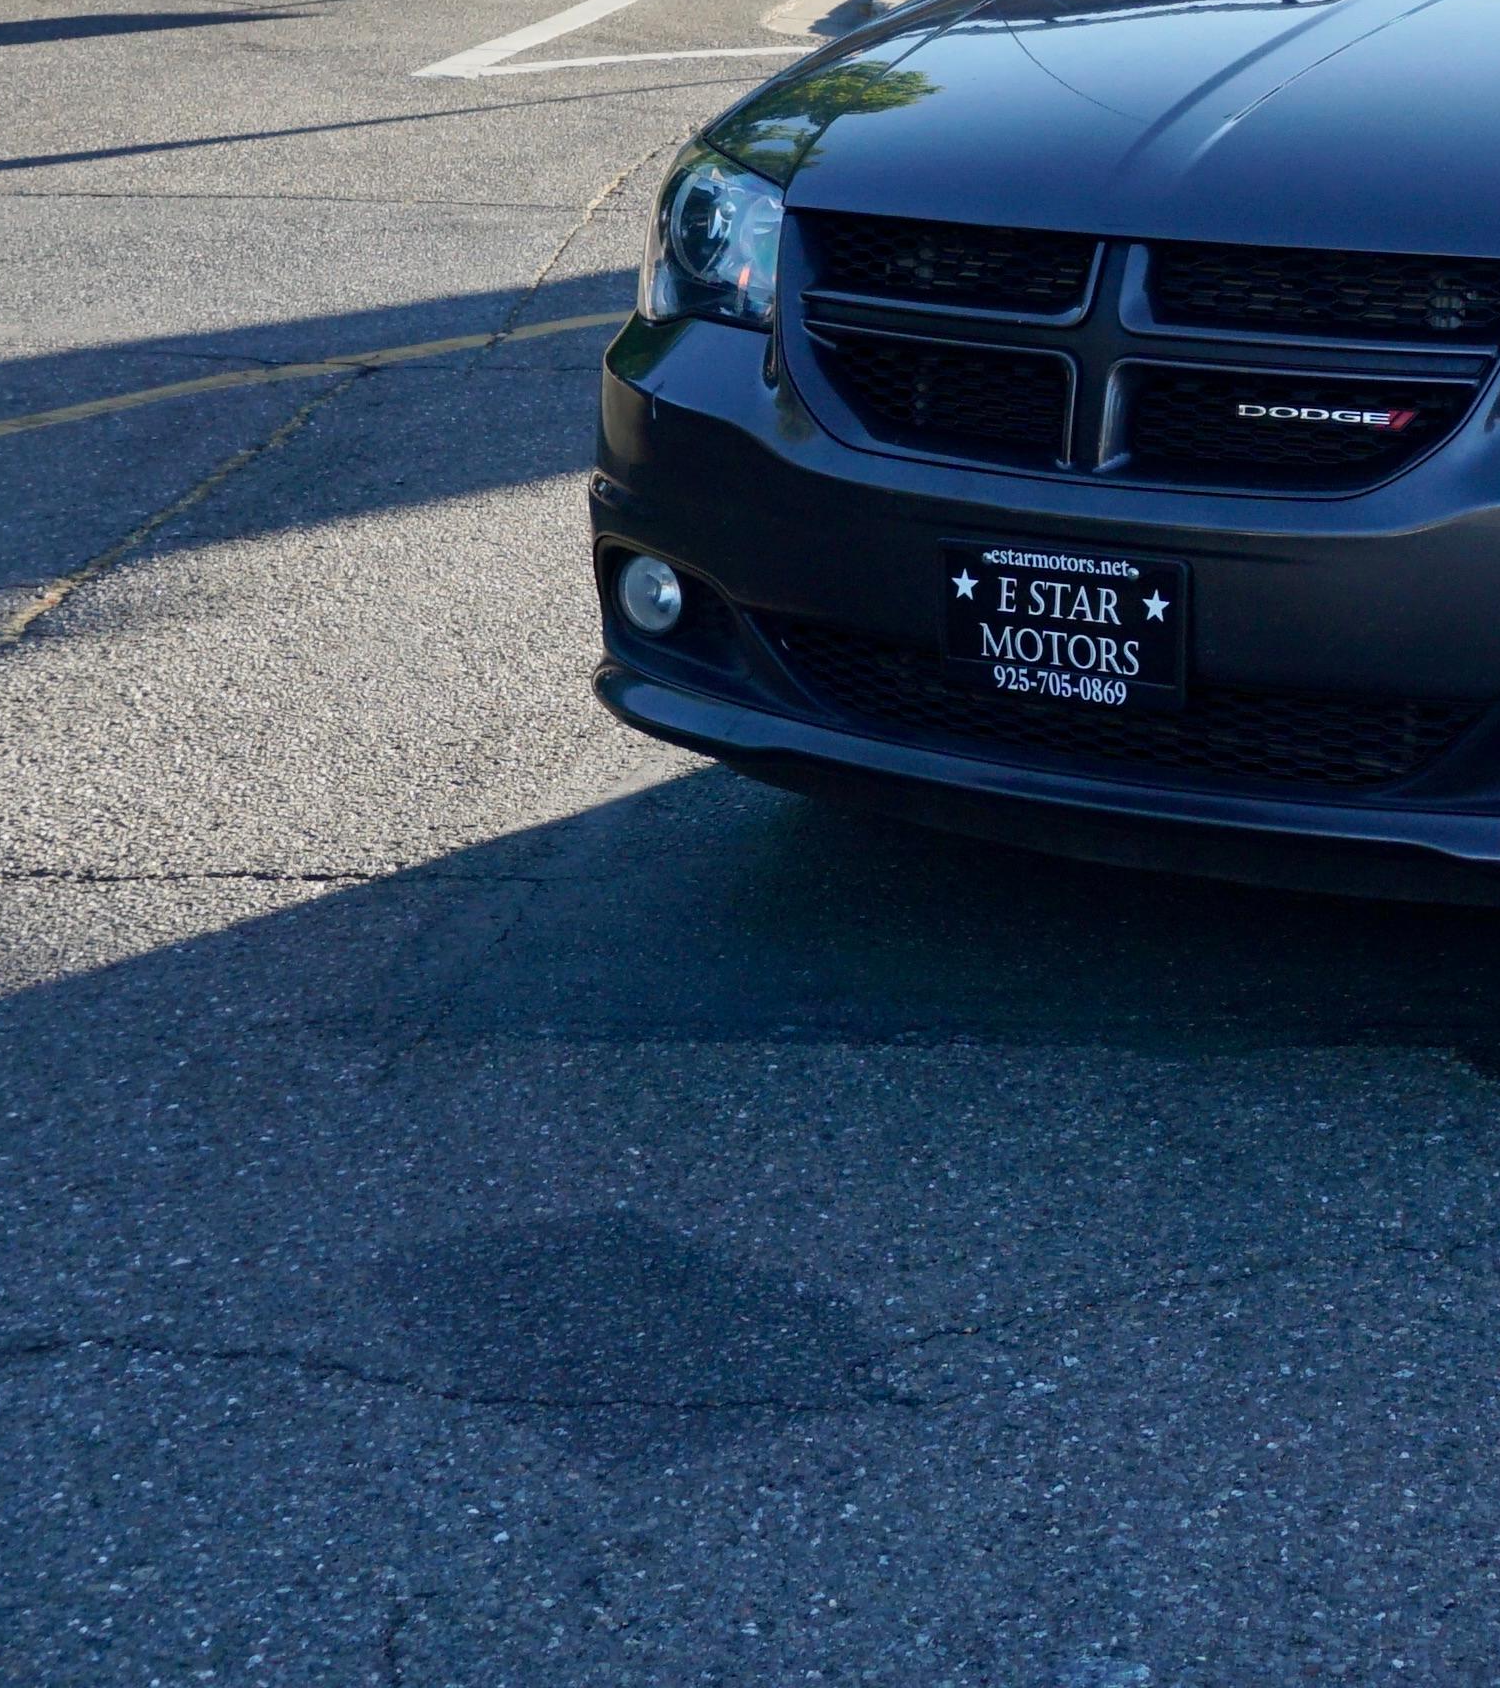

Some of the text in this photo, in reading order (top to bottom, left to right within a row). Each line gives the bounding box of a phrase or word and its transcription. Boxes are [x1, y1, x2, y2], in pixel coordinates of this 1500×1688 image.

[1238, 404, 1391, 425] DODGE
[991, 549, 1129, 577] estarmotors.net
[997, 576, 1122, 626] E STAR
[978, 622, 1140, 676] MOTORS
[993, 665, 1128, 706] 925-705-0869
